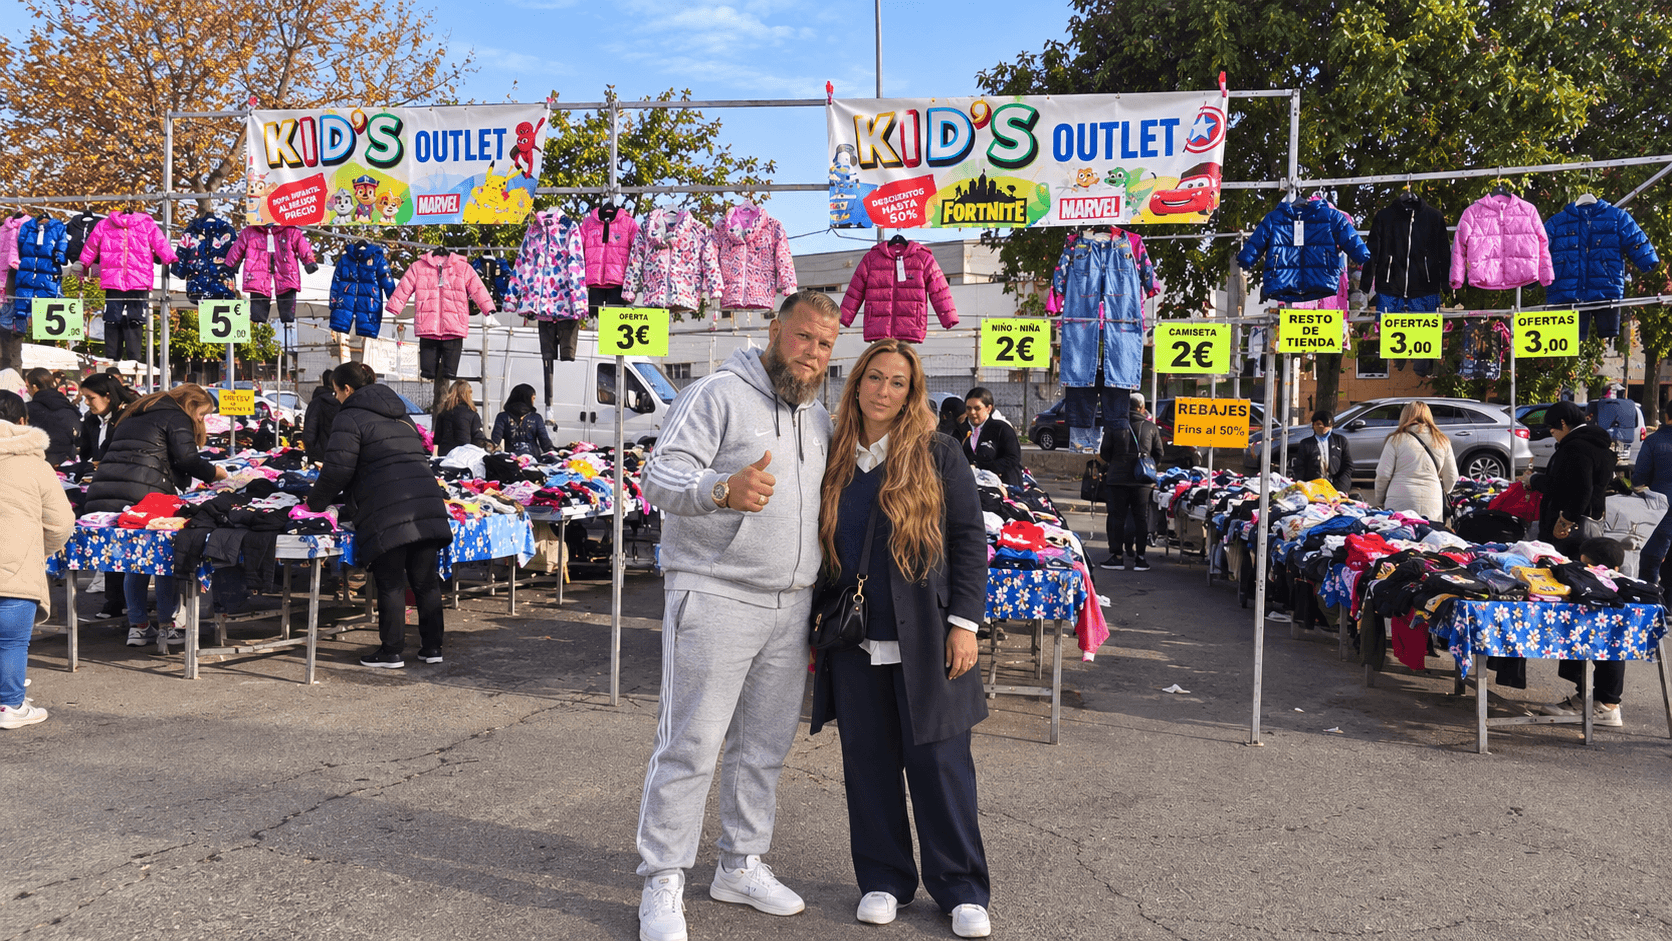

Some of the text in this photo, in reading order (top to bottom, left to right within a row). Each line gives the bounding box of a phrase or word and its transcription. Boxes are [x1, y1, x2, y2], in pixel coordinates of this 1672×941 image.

[263, 109, 507, 169] KID'S OUTLET
[853, 101, 1180, 170] KID'S OUTLET
[418, 195, 459, 214] MARVEL
[943, 200, 1025, 223] FORTNITE
[1061, 197, 1118, 219] MARVEL
[285, 205, 317, 221] PRECIO
[889, 209, 918, 224] 50%
[619, 313, 648, 321] OFERTA
[1289, 314, 1333, 324] RESTO
[1384, 319, 1439, 328] OFERTAS
[1518, 315, 1575, 327] OFERTAS
[1020, 323, 1041, 332] NIÑA
[1168, 328, 1217, 337] CAMISETA
[1302, 326, 1319, 336] DE
[616, 324, 650, 350] 3€
[1286, 338, 1335, 347] TIENDA
[1389, 332, 1432, 356] 3,00
[1524, 330, 1569, 355] 3,00
[995, 336, 1035, 362] 2€
[1170, 341, 1214, 368] 2€
[1178, 403, 1247, 417] REBAJES
[1177, 424, 1245, 436] Fins al 50%
